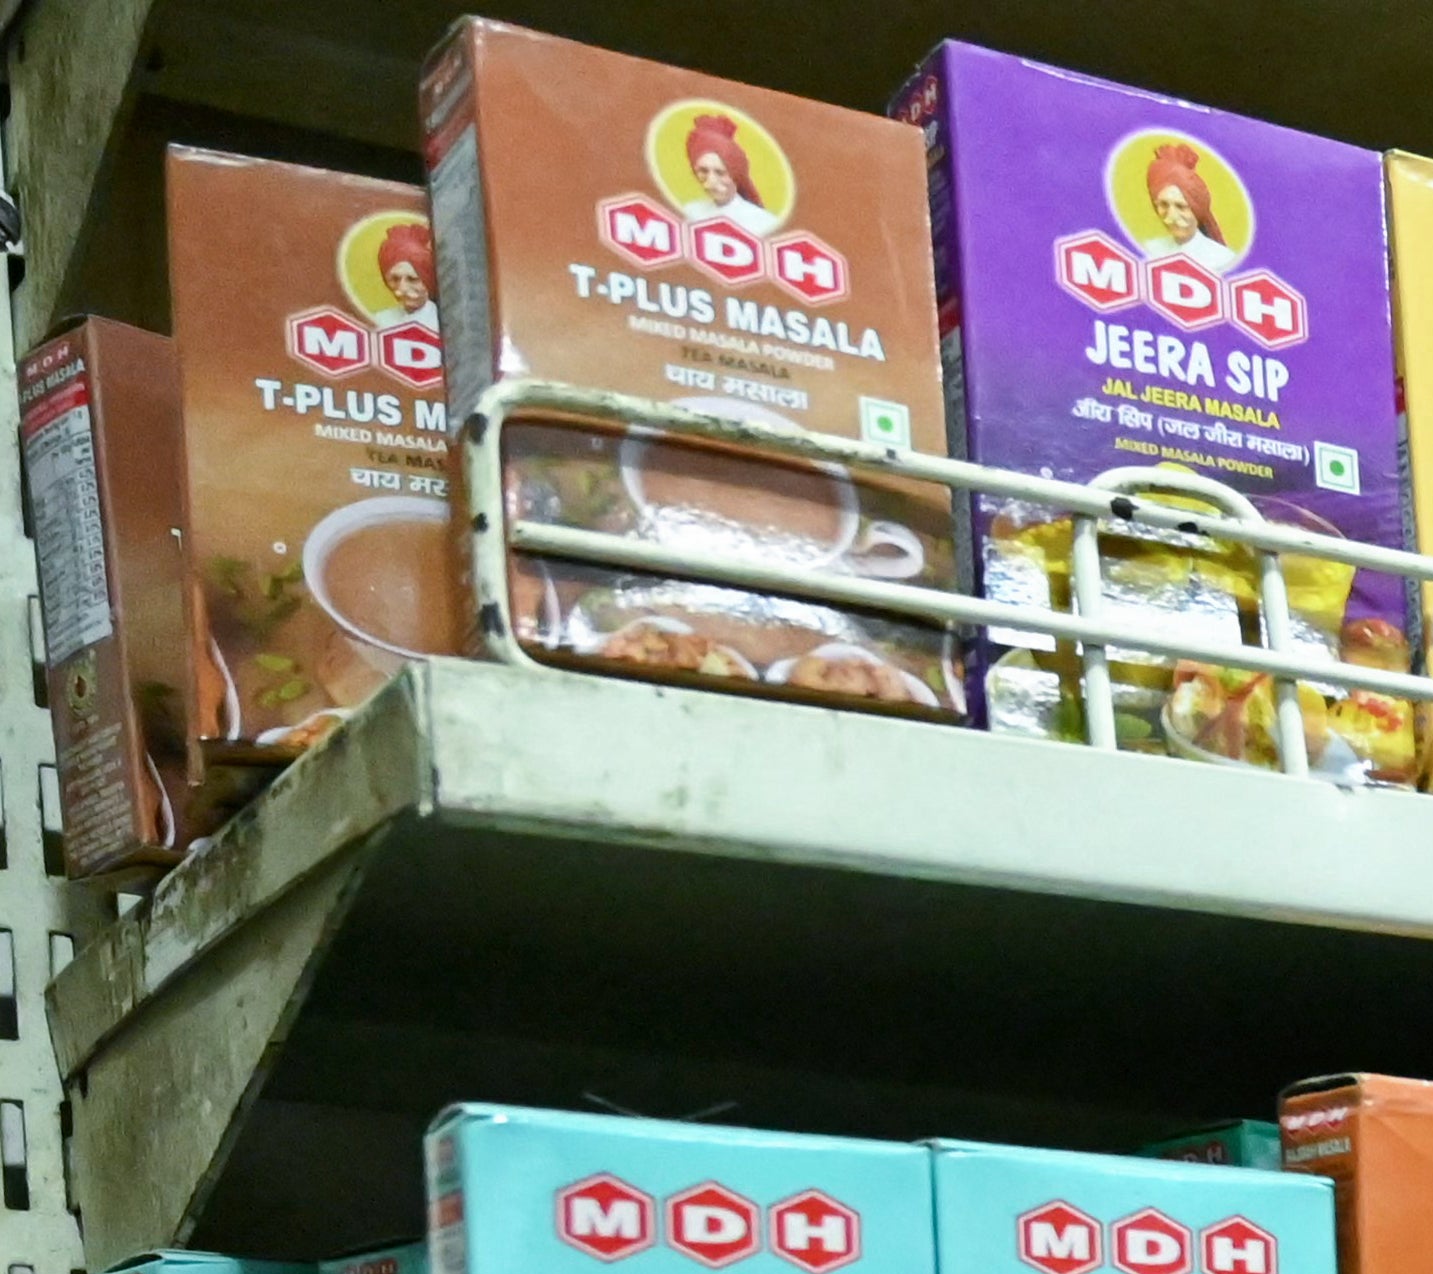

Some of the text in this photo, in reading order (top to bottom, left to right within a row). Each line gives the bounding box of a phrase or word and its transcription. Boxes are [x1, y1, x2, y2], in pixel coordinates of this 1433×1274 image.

[569, 263, 886, 361] T-PLUS MASALA
[724, 372, 809, 410] मसाला
[1085, 319, 1290, 403] JEERA SIP
[1101, 377, 1281, 430] JAL JEERA MASALA
